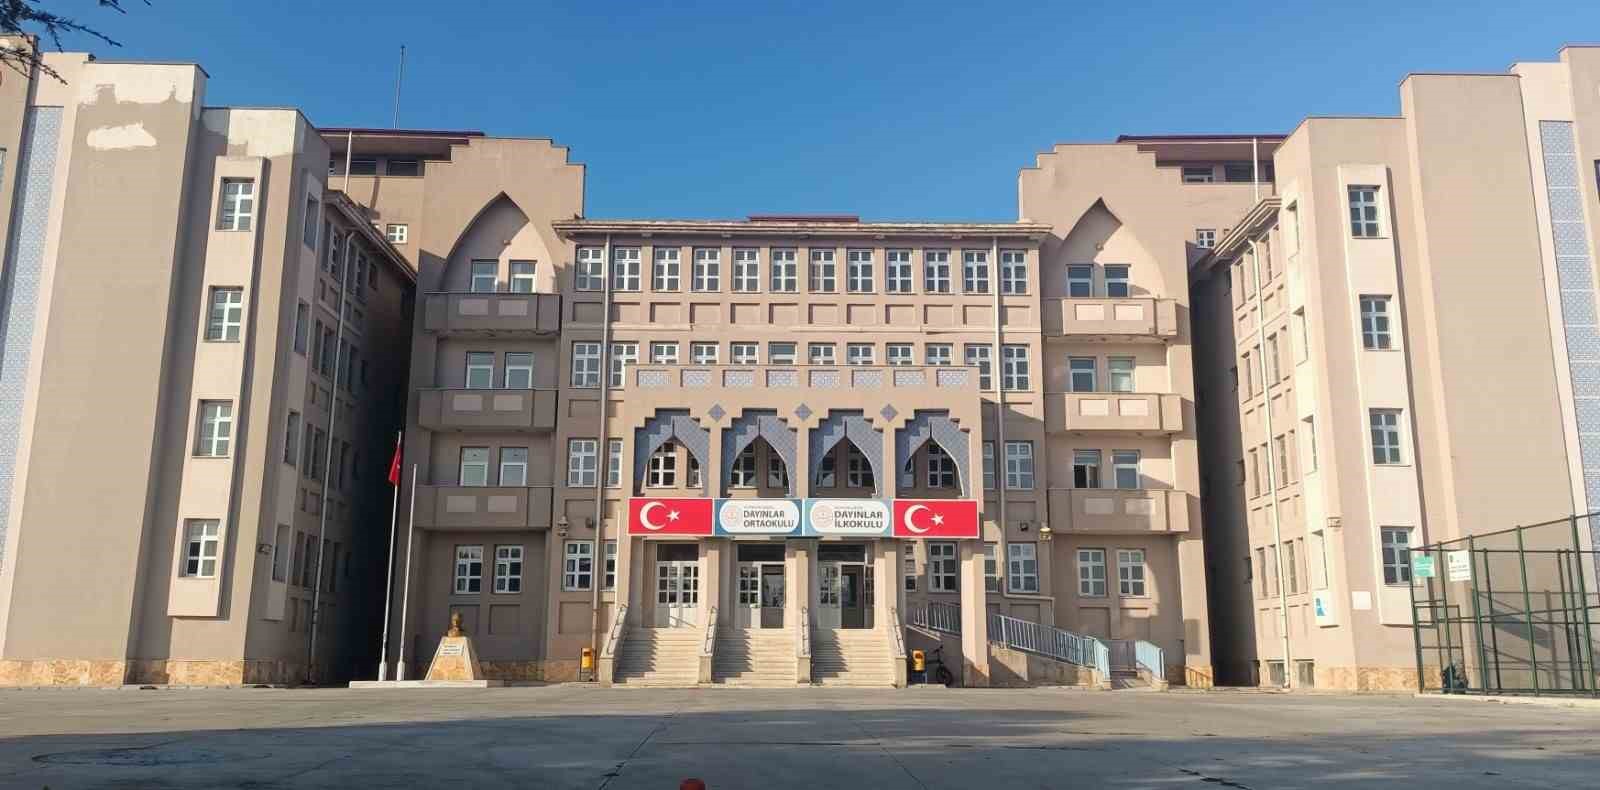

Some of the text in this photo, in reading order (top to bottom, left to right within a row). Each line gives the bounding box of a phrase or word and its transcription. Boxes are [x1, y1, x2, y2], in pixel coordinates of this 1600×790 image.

[743, 510, 785, 518] DAYINLAR
[834, 510, 883, 518] DAYINLAR
[743, 519, 795, 528] ORTAOKULU
[834, 519, 883, 528] İLKOKULU
